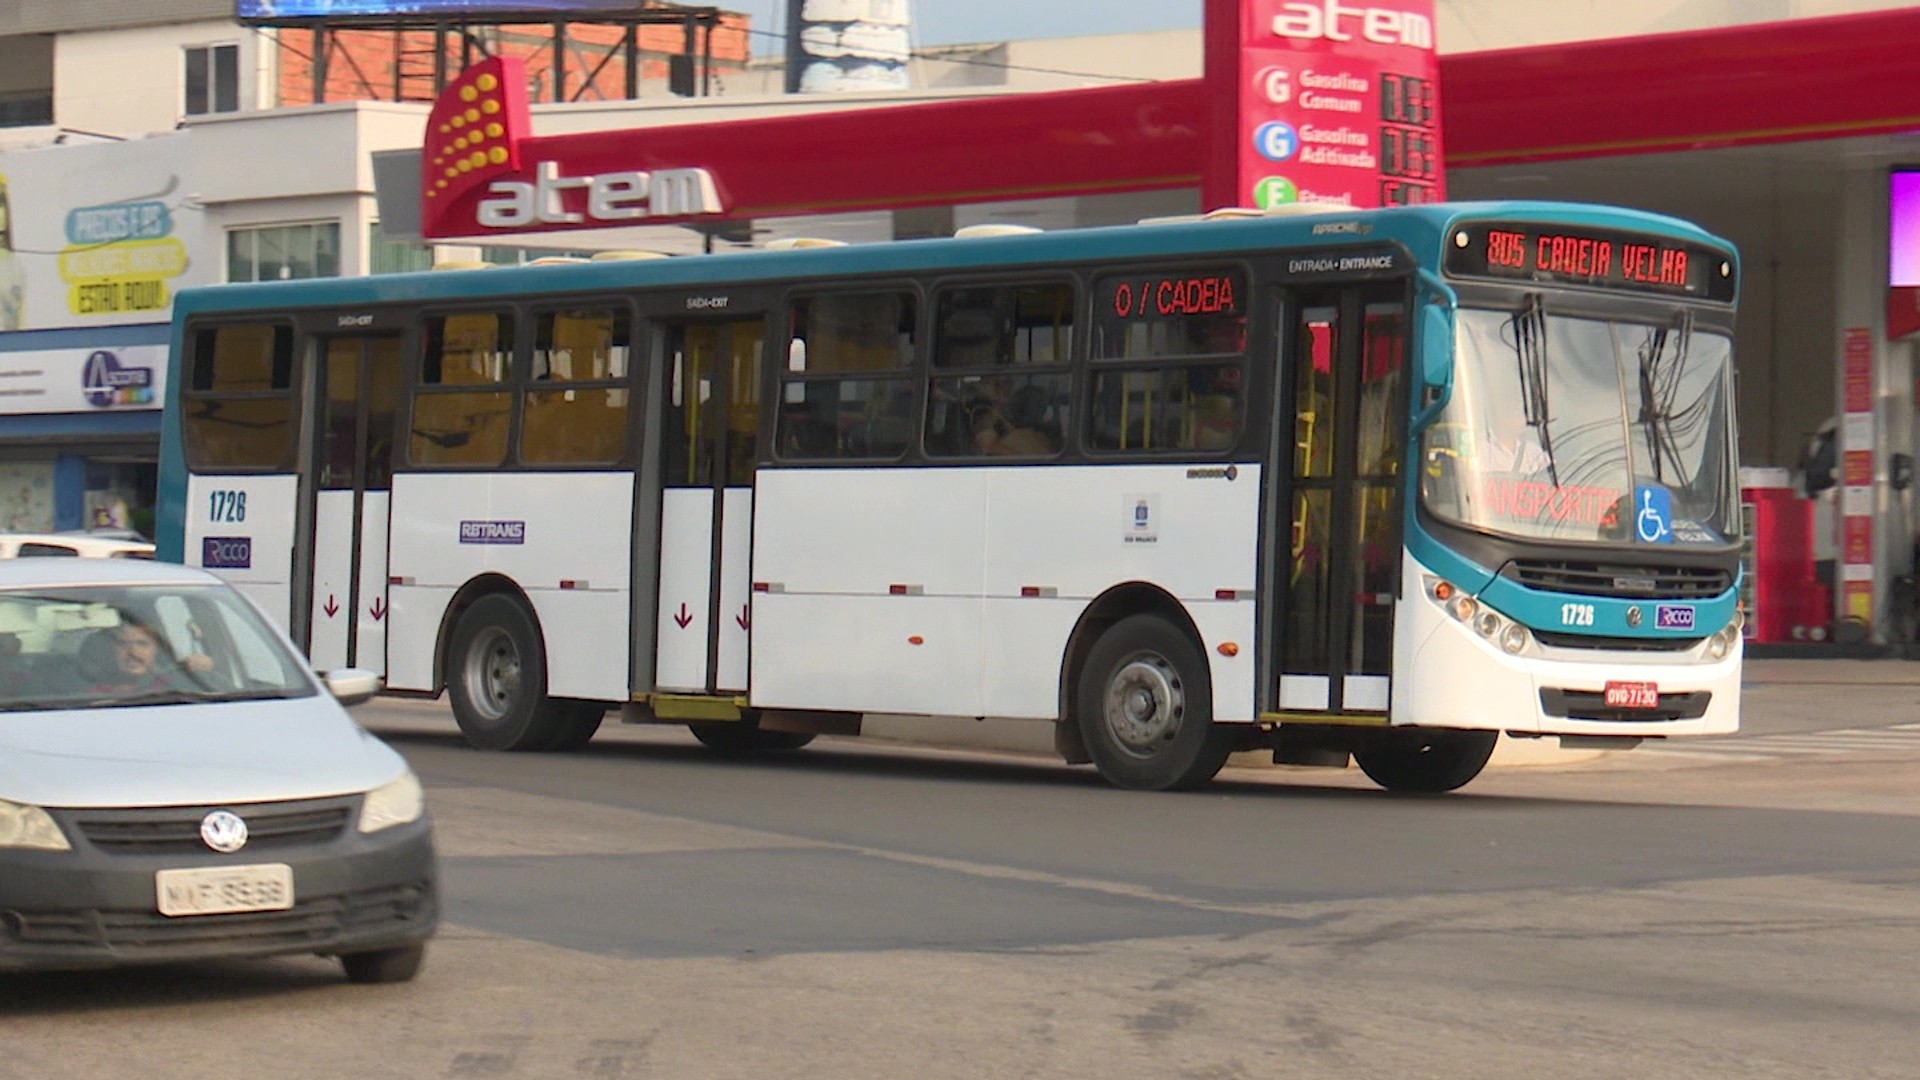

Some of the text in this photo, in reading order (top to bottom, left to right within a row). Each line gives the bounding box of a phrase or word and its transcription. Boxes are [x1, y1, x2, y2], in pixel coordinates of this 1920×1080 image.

[1271, 0, 1433, 49] atem
[1265, 70, 1290, 103] G
[1299, 70, 1369, 92] Gasolina
[1299, 91, 1362, 112] Comum
[1264, 126, 1290, 158] G
[1299, 125, 1369, 146] Gasolina
[1299, 147, 1376, 168] Aditivada
[476, 161, 722, 227] atem
[1487, 231, 1687, 285] 805 CADEIA VELHA
[1156, 278, 1234, 315] CADEIA
[209, 490, 246, 522] 1726
[462, 523, 523, 538] RBTRANS
[1561, 604, 1594, 626] 1726
